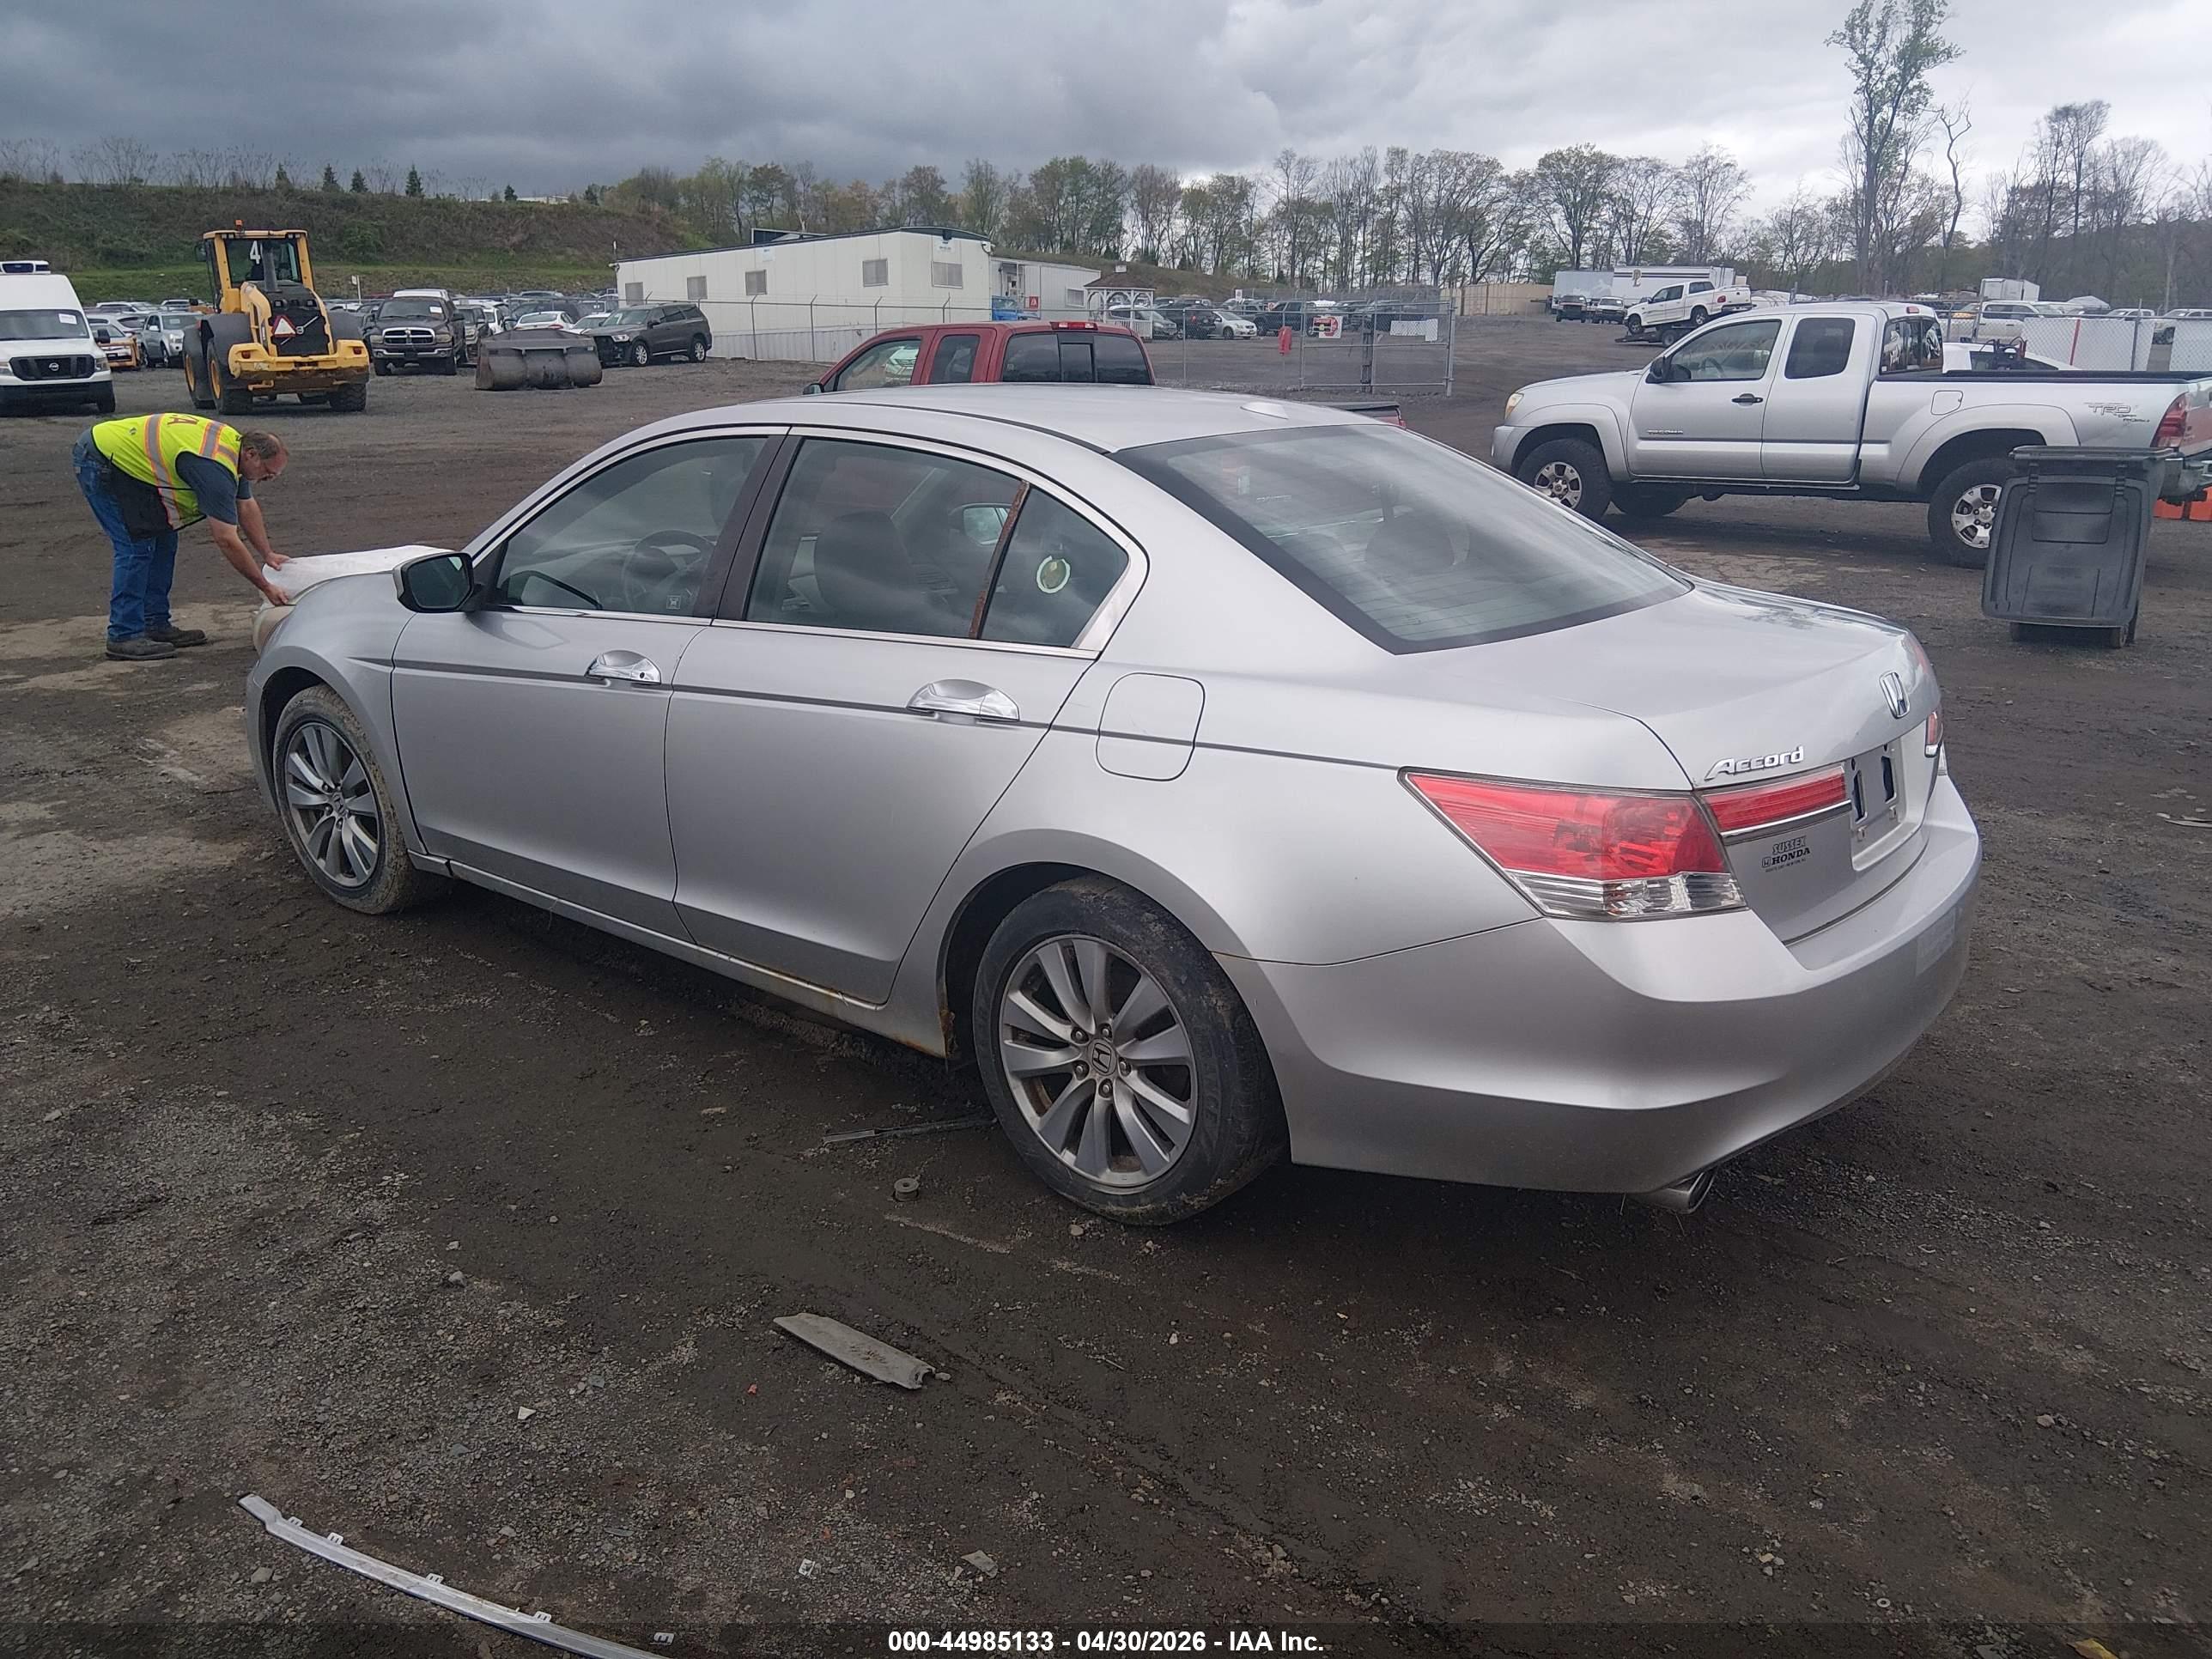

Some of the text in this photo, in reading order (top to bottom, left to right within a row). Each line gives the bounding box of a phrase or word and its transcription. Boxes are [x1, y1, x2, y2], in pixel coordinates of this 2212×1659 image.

[1704, 744, 1804, 781] Accord
[1771, 836, 1807, 855] SUSSEX
[1771, 847, 1811, 866] HONDA
